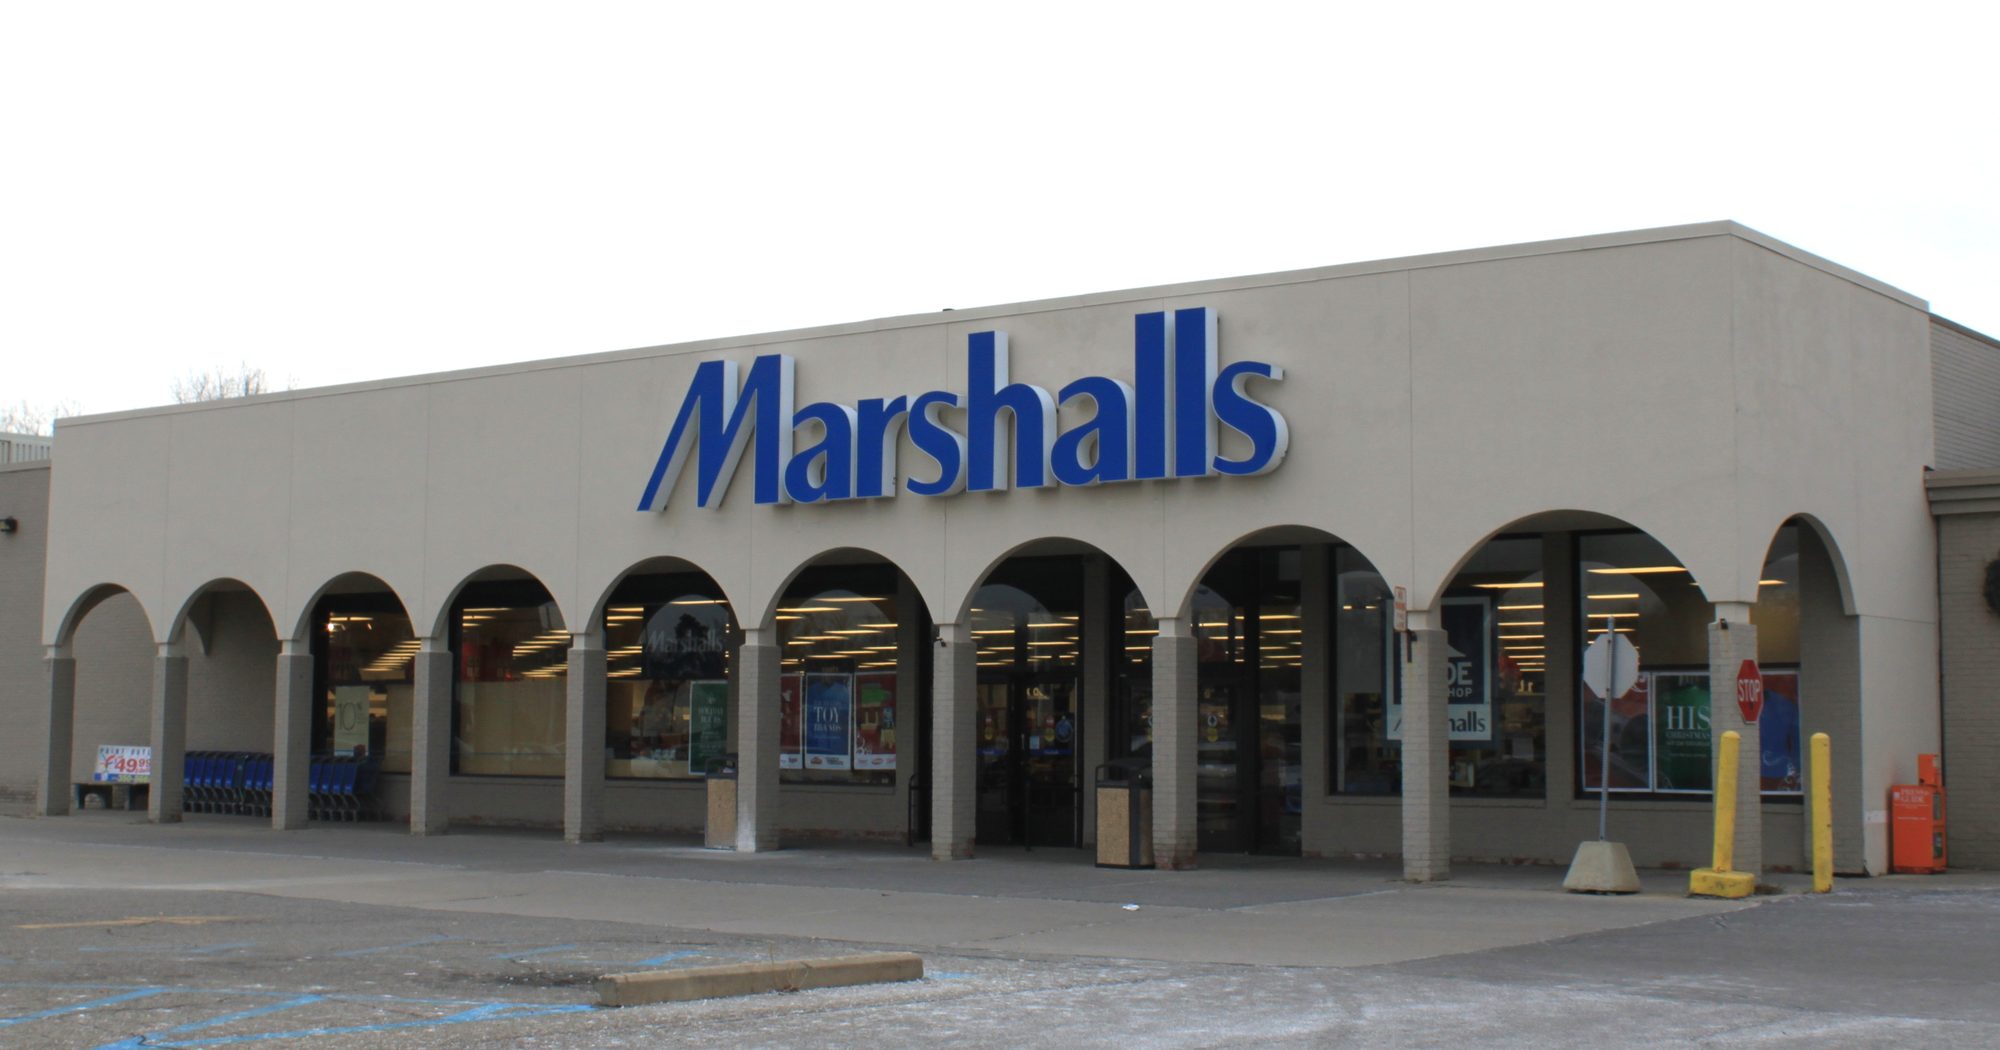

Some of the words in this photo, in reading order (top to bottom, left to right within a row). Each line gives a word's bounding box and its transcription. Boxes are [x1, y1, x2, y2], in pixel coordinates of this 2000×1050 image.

[637, 306, 1289, 512] Marshalls
[1738, 679, 1760, 702] STOP
[813, 706, 840, 723] TOY
[1666, 704, 1712, 731] HIS
